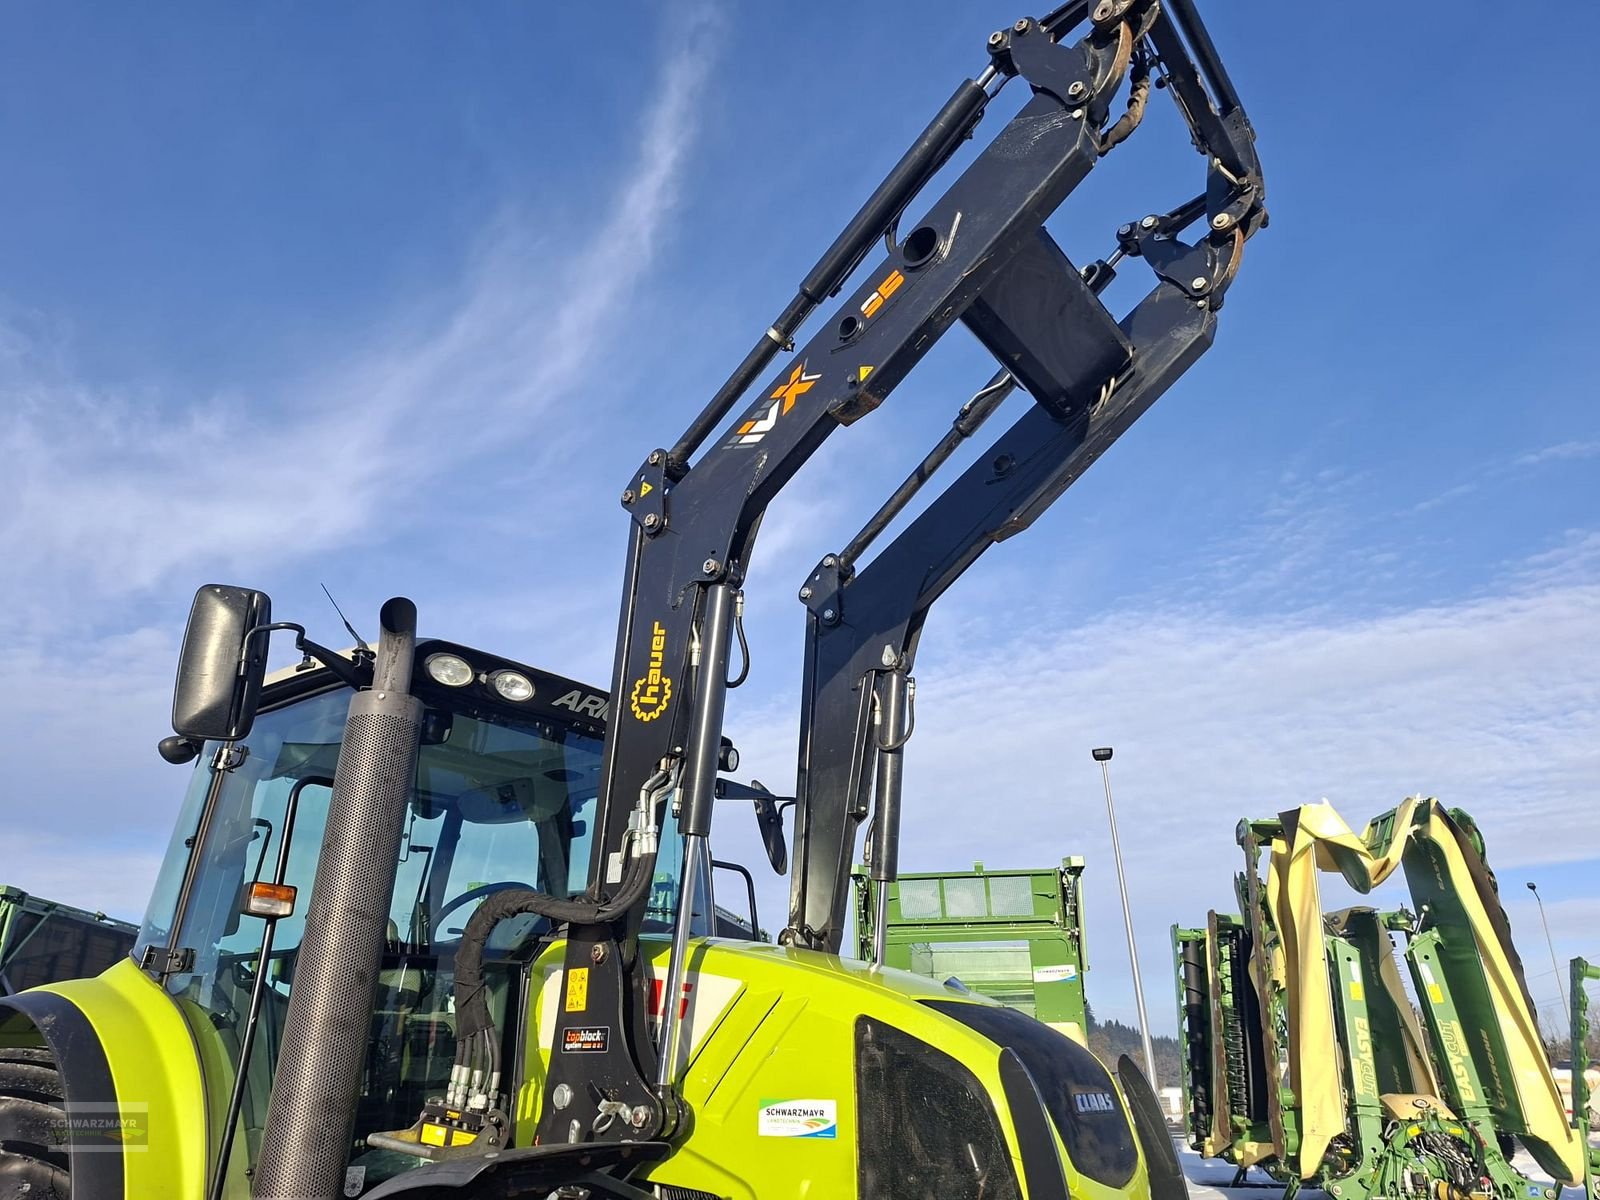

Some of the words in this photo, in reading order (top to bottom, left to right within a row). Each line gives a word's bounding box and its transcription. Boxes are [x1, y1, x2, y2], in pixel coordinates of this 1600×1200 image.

[640, 621, 666, 704] hauer
[551, 689, 610, 721] ARI
[566, 1030, 602, 1043] topblock
[765, 1108, 825, 1117] SCHWARZMAYR
[1075, 1093, 1115, 1113] CLAAS
